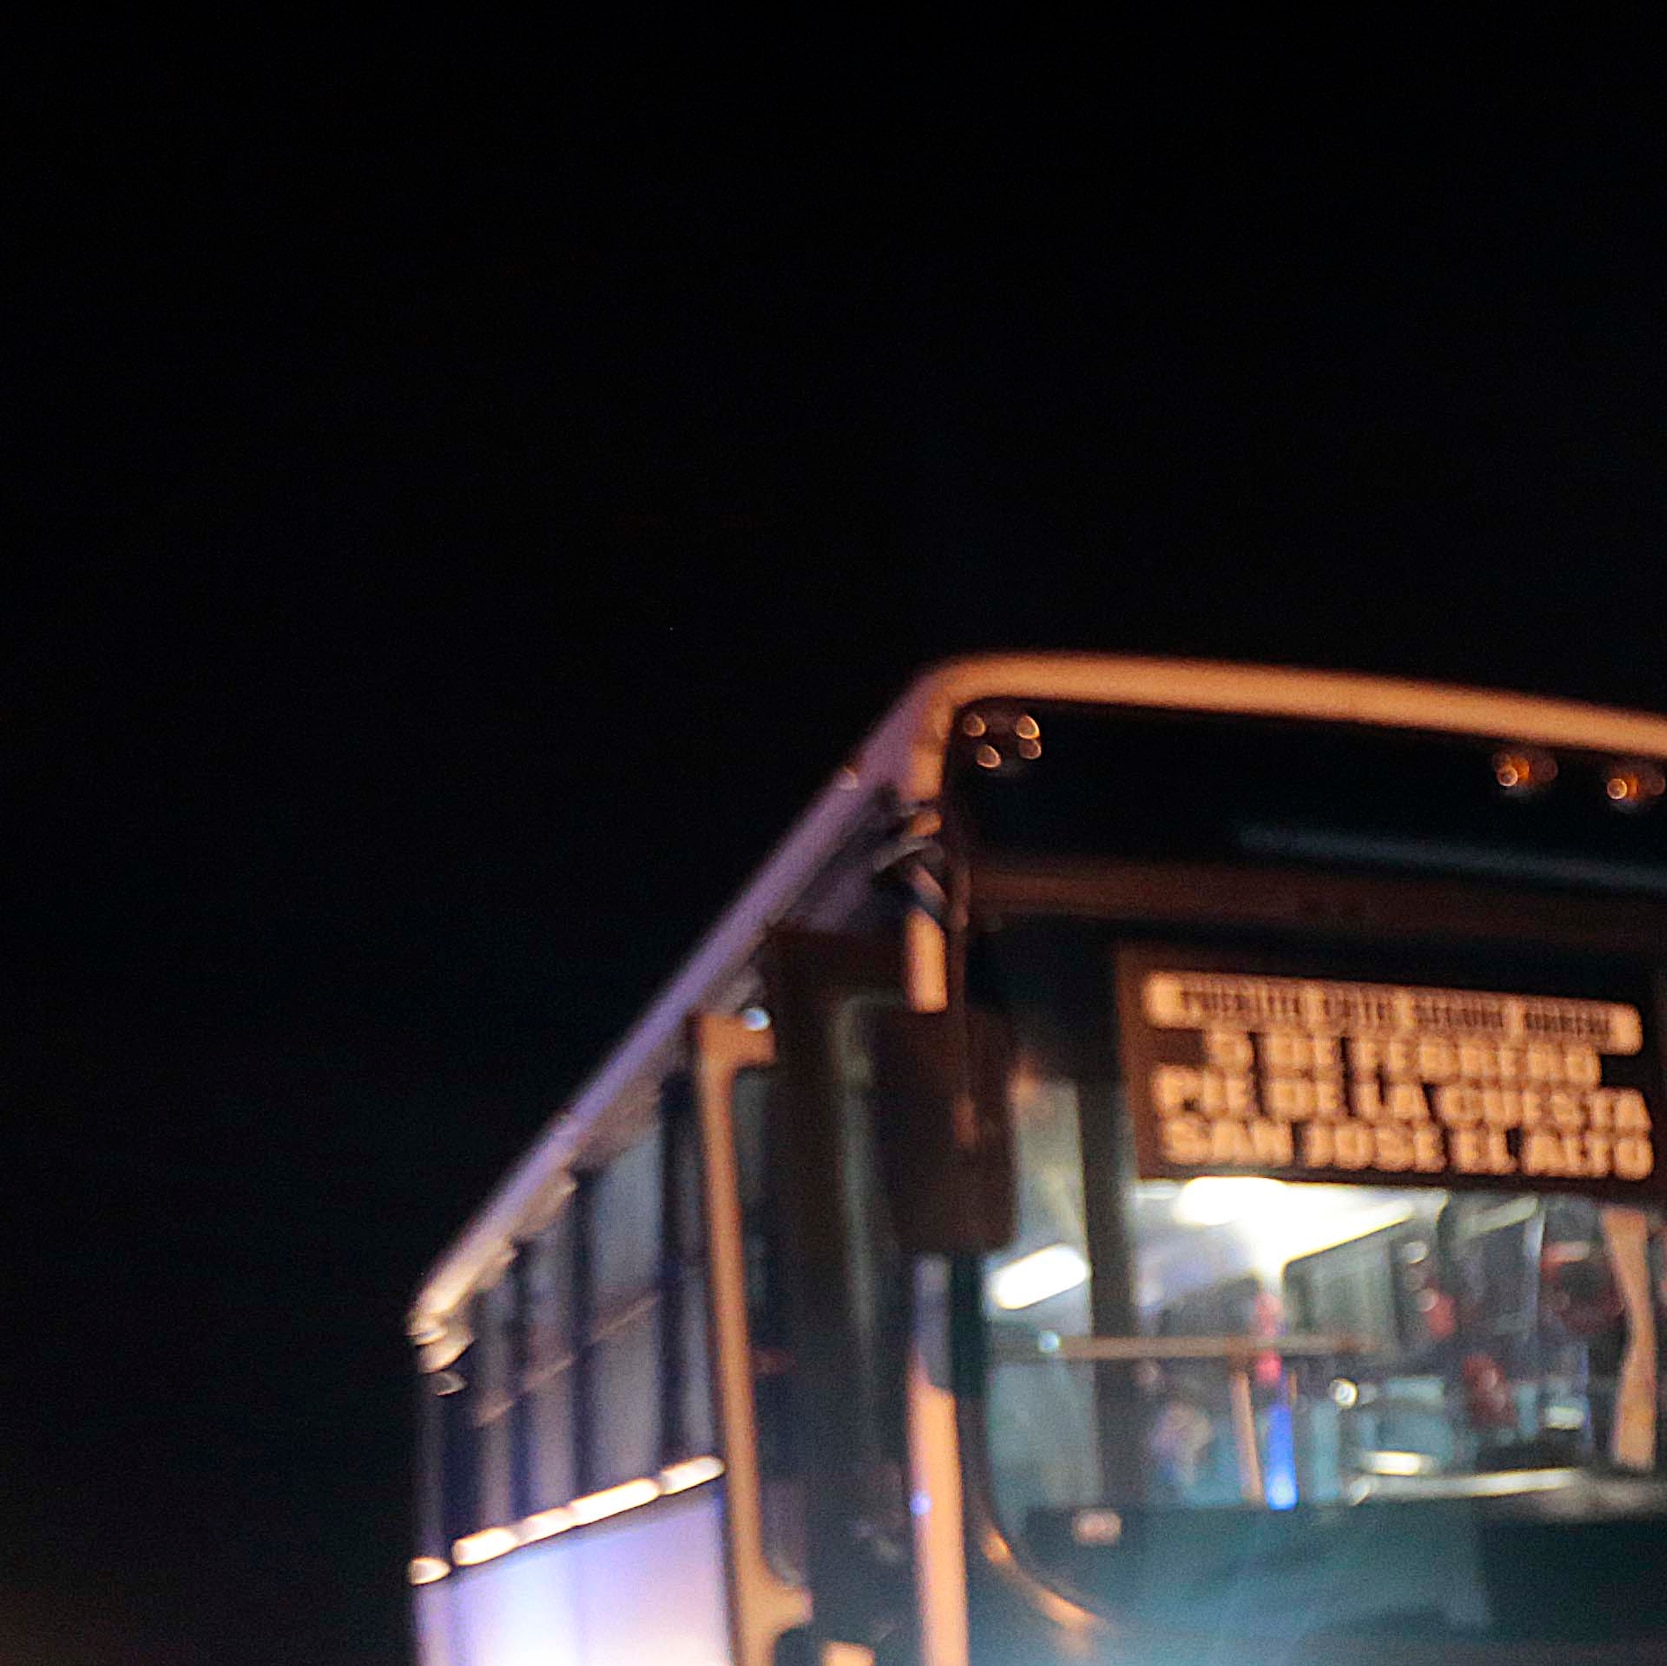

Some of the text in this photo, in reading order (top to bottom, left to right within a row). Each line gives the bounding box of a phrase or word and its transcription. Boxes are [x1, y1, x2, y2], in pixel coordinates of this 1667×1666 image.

[1264, 1075, 1343, 1124] DE
[1161, 1118, 1654, 1181] SAN JOSE EL ALTO
